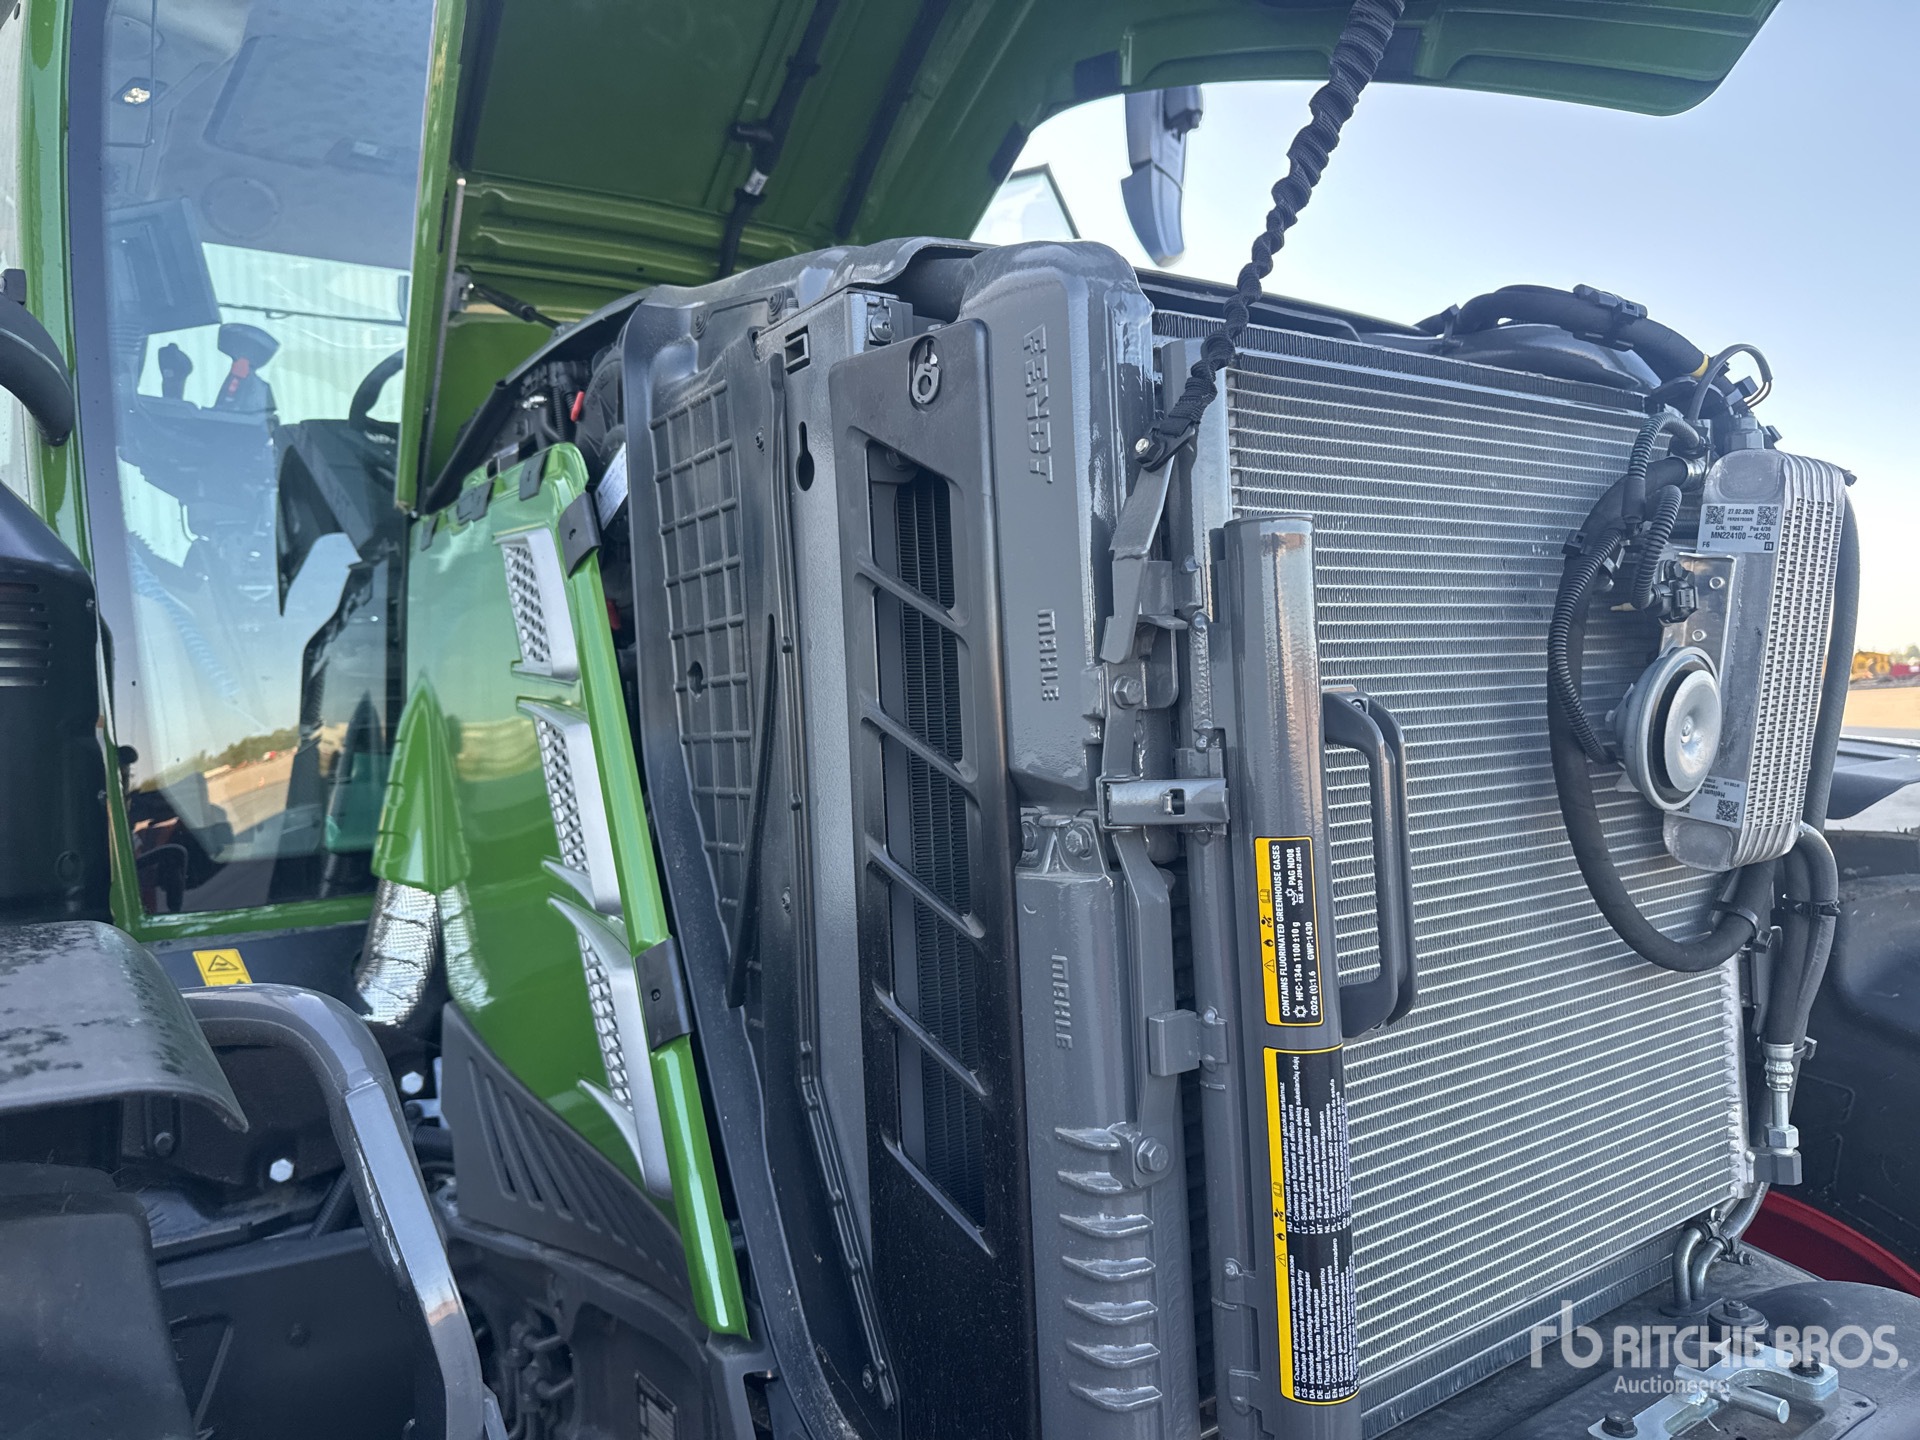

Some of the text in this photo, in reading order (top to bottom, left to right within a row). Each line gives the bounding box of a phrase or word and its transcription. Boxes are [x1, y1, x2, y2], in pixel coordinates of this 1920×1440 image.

[1023, 324, 1053, 484] FENDT
[1037, 608, 1060, 702] MAHLE
[1287, 849, 1296, 885] PAG ND08
[1272, 845, 1290, 1016] CONTAINS FLUORINATED GREENHOUSE GASES
[1305, 922, 1315, 960] GWP:1430
[1292, 944, 1301, 962] 1100
[1295, 964, 1304, 1001] HFC-134a
[1308, 971, 1318, 994] (t):1.6
[1051, 955, 1073, 1050] MAHLE
[1287, 1222, 1292, 1232] HU
[1302, 1226, 1308, 1234] LT
[1310, 1226, 1315, 1234] LV
[1317, 1224, 1323, 1234] MT
[1325, 1224, 1330, 1233] NL
[1302, 1388, 1307, 1397] CS
[1309, 1389, 1315, 1398] DA
[1317, 1390, 1323, 1399] DE
[1332, 1389, 1337, 1398] EN
